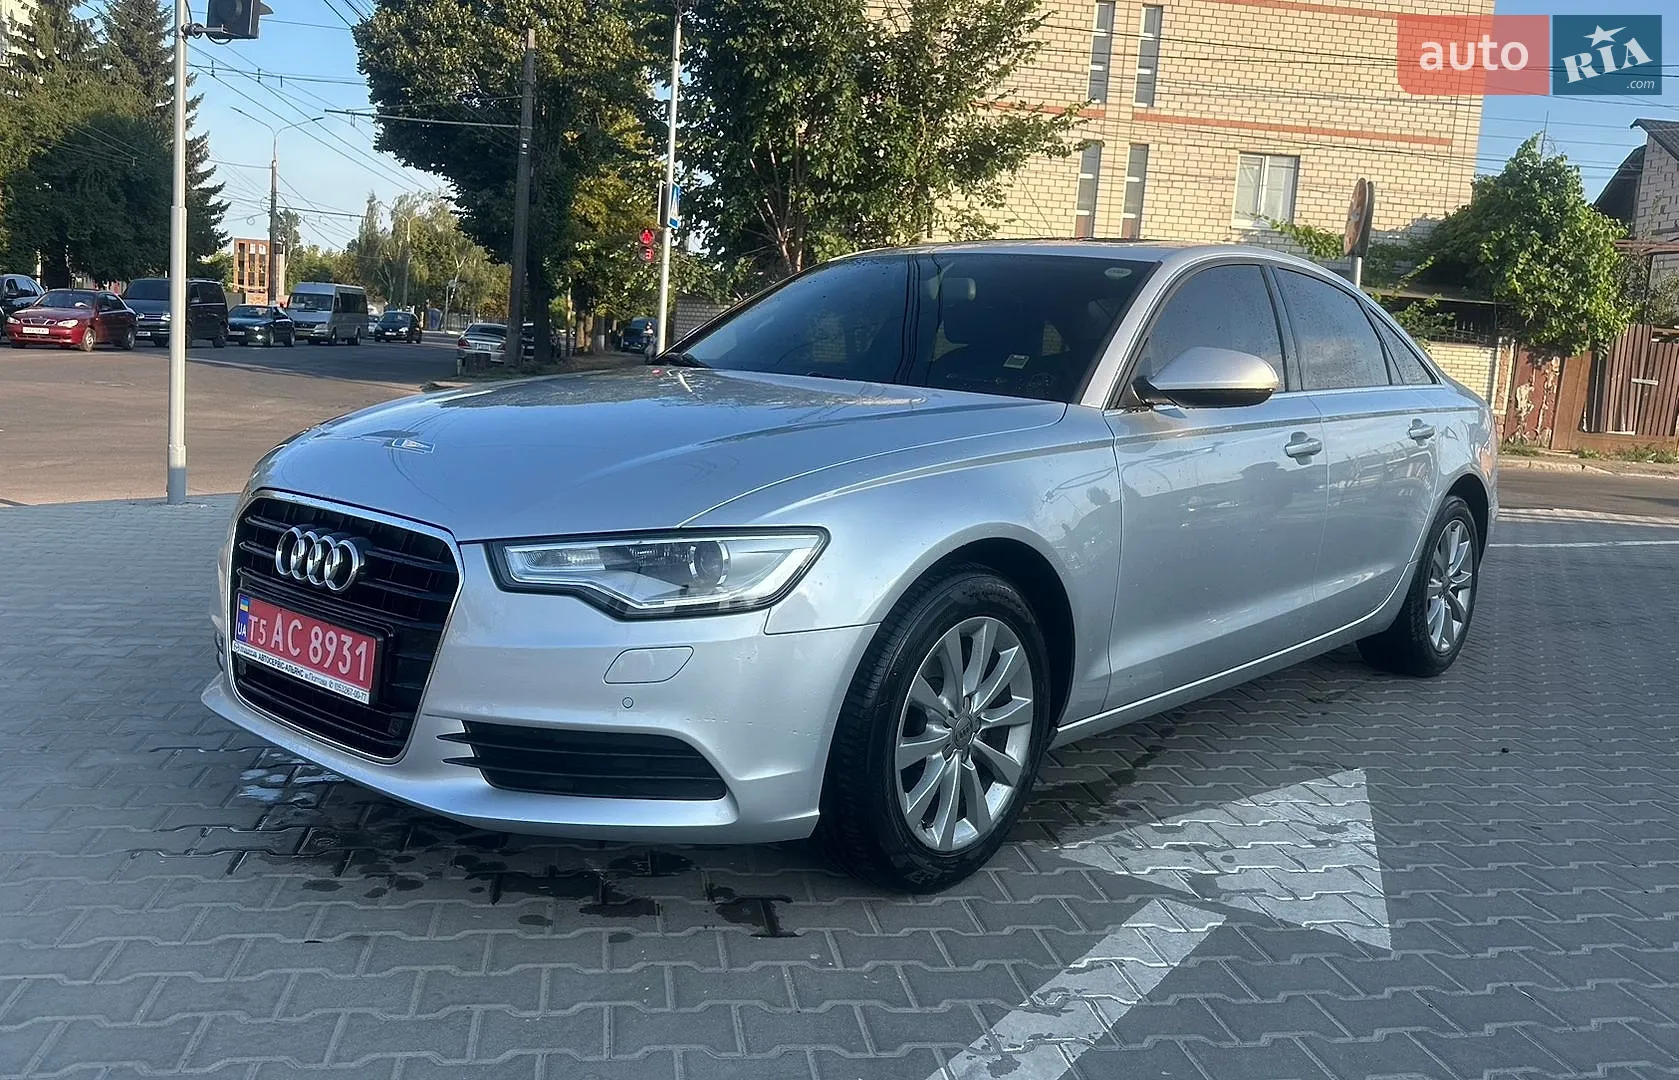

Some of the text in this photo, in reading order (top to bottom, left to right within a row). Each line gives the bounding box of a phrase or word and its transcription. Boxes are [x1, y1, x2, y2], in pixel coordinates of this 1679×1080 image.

[237, 622, 247, 638] UA
[248, 612, 368, 682] T5 AC 8931
